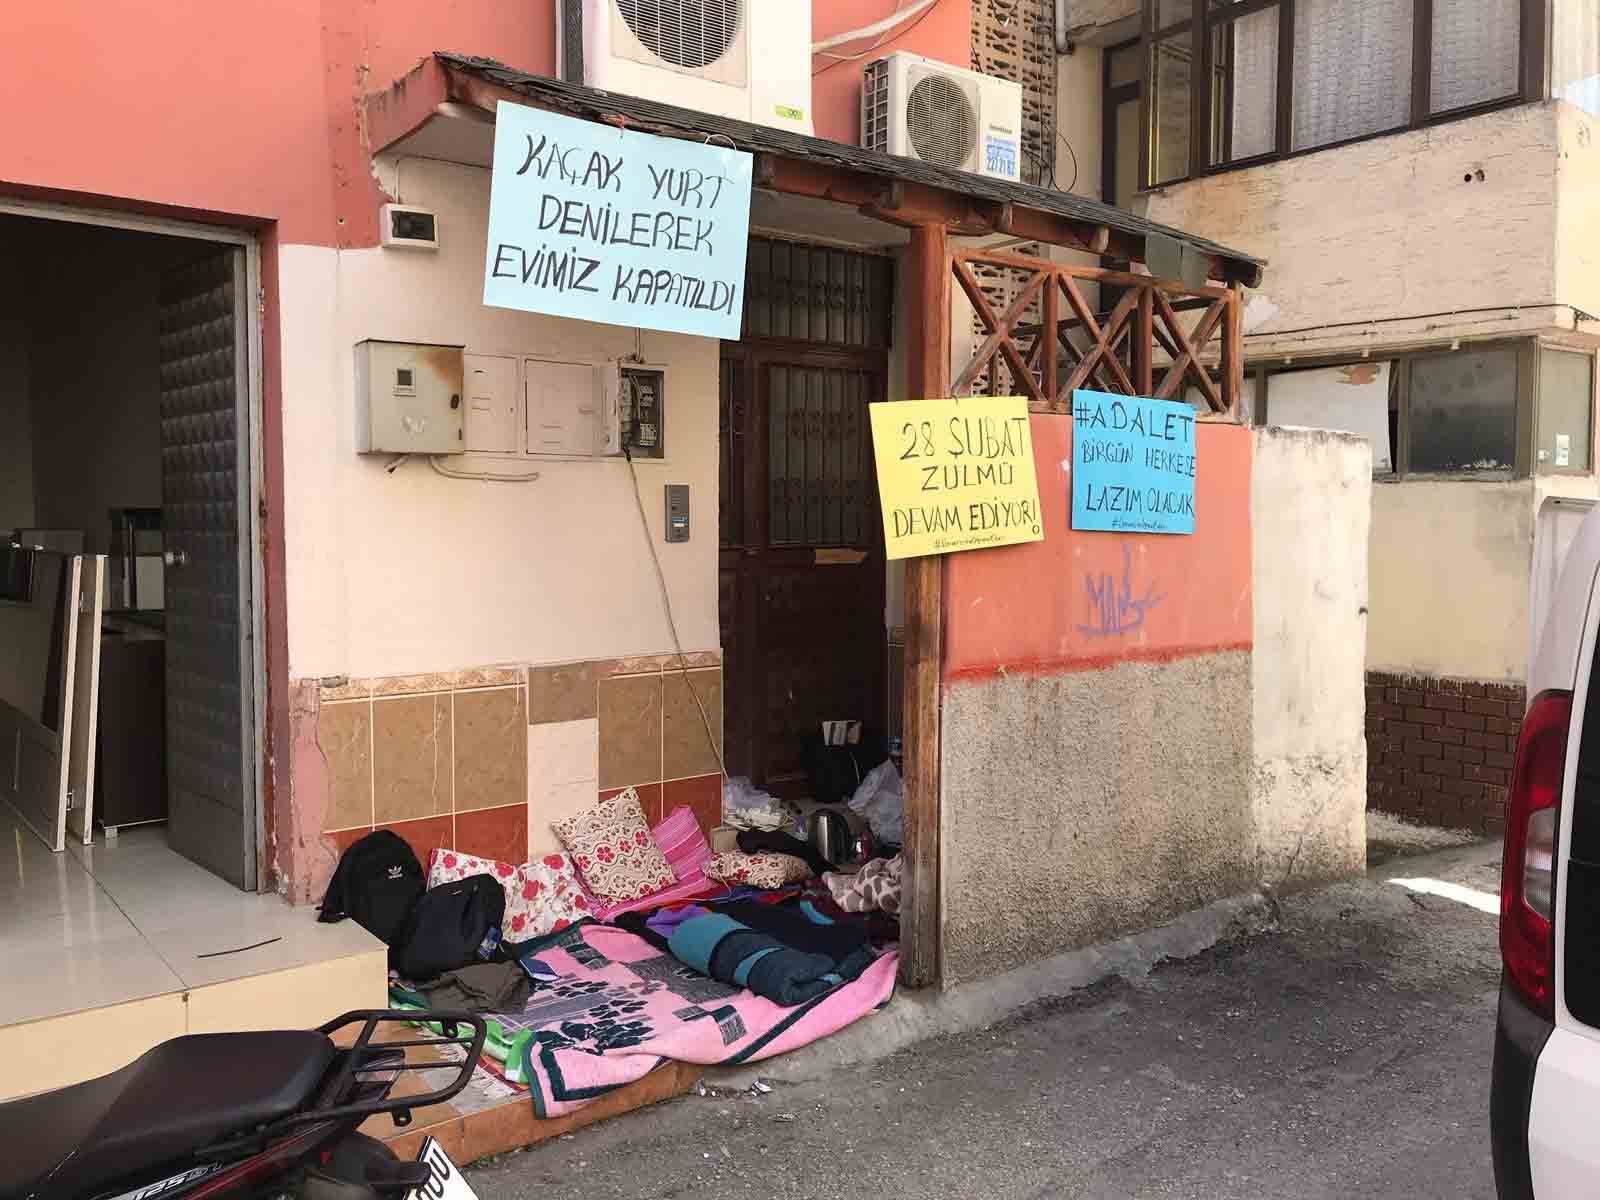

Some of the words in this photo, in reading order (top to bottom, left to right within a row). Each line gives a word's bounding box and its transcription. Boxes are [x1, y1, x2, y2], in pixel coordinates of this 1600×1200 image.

[517, 134, 623, 192] KAÇAK
[648, 164, 735, 209] YURT
[538, 194, 713, 256] DENİLEREK
[492, 243, 600, 292] EVİMİZ
[612, 264, 736, 315] KAPATILDI
[900, 421, 935, 460] 28
[1075, 401, 1192, 441] #ADALET
[1145, 448, 1196, 478] HERKESE
[894, 503, 963, 538] DEVAM
[969, 498, 1041, 535] EDİYOR!
[1086, 484, 1143, 512] LAZIM
[1147, 488, 1195, 518] OLACAK
